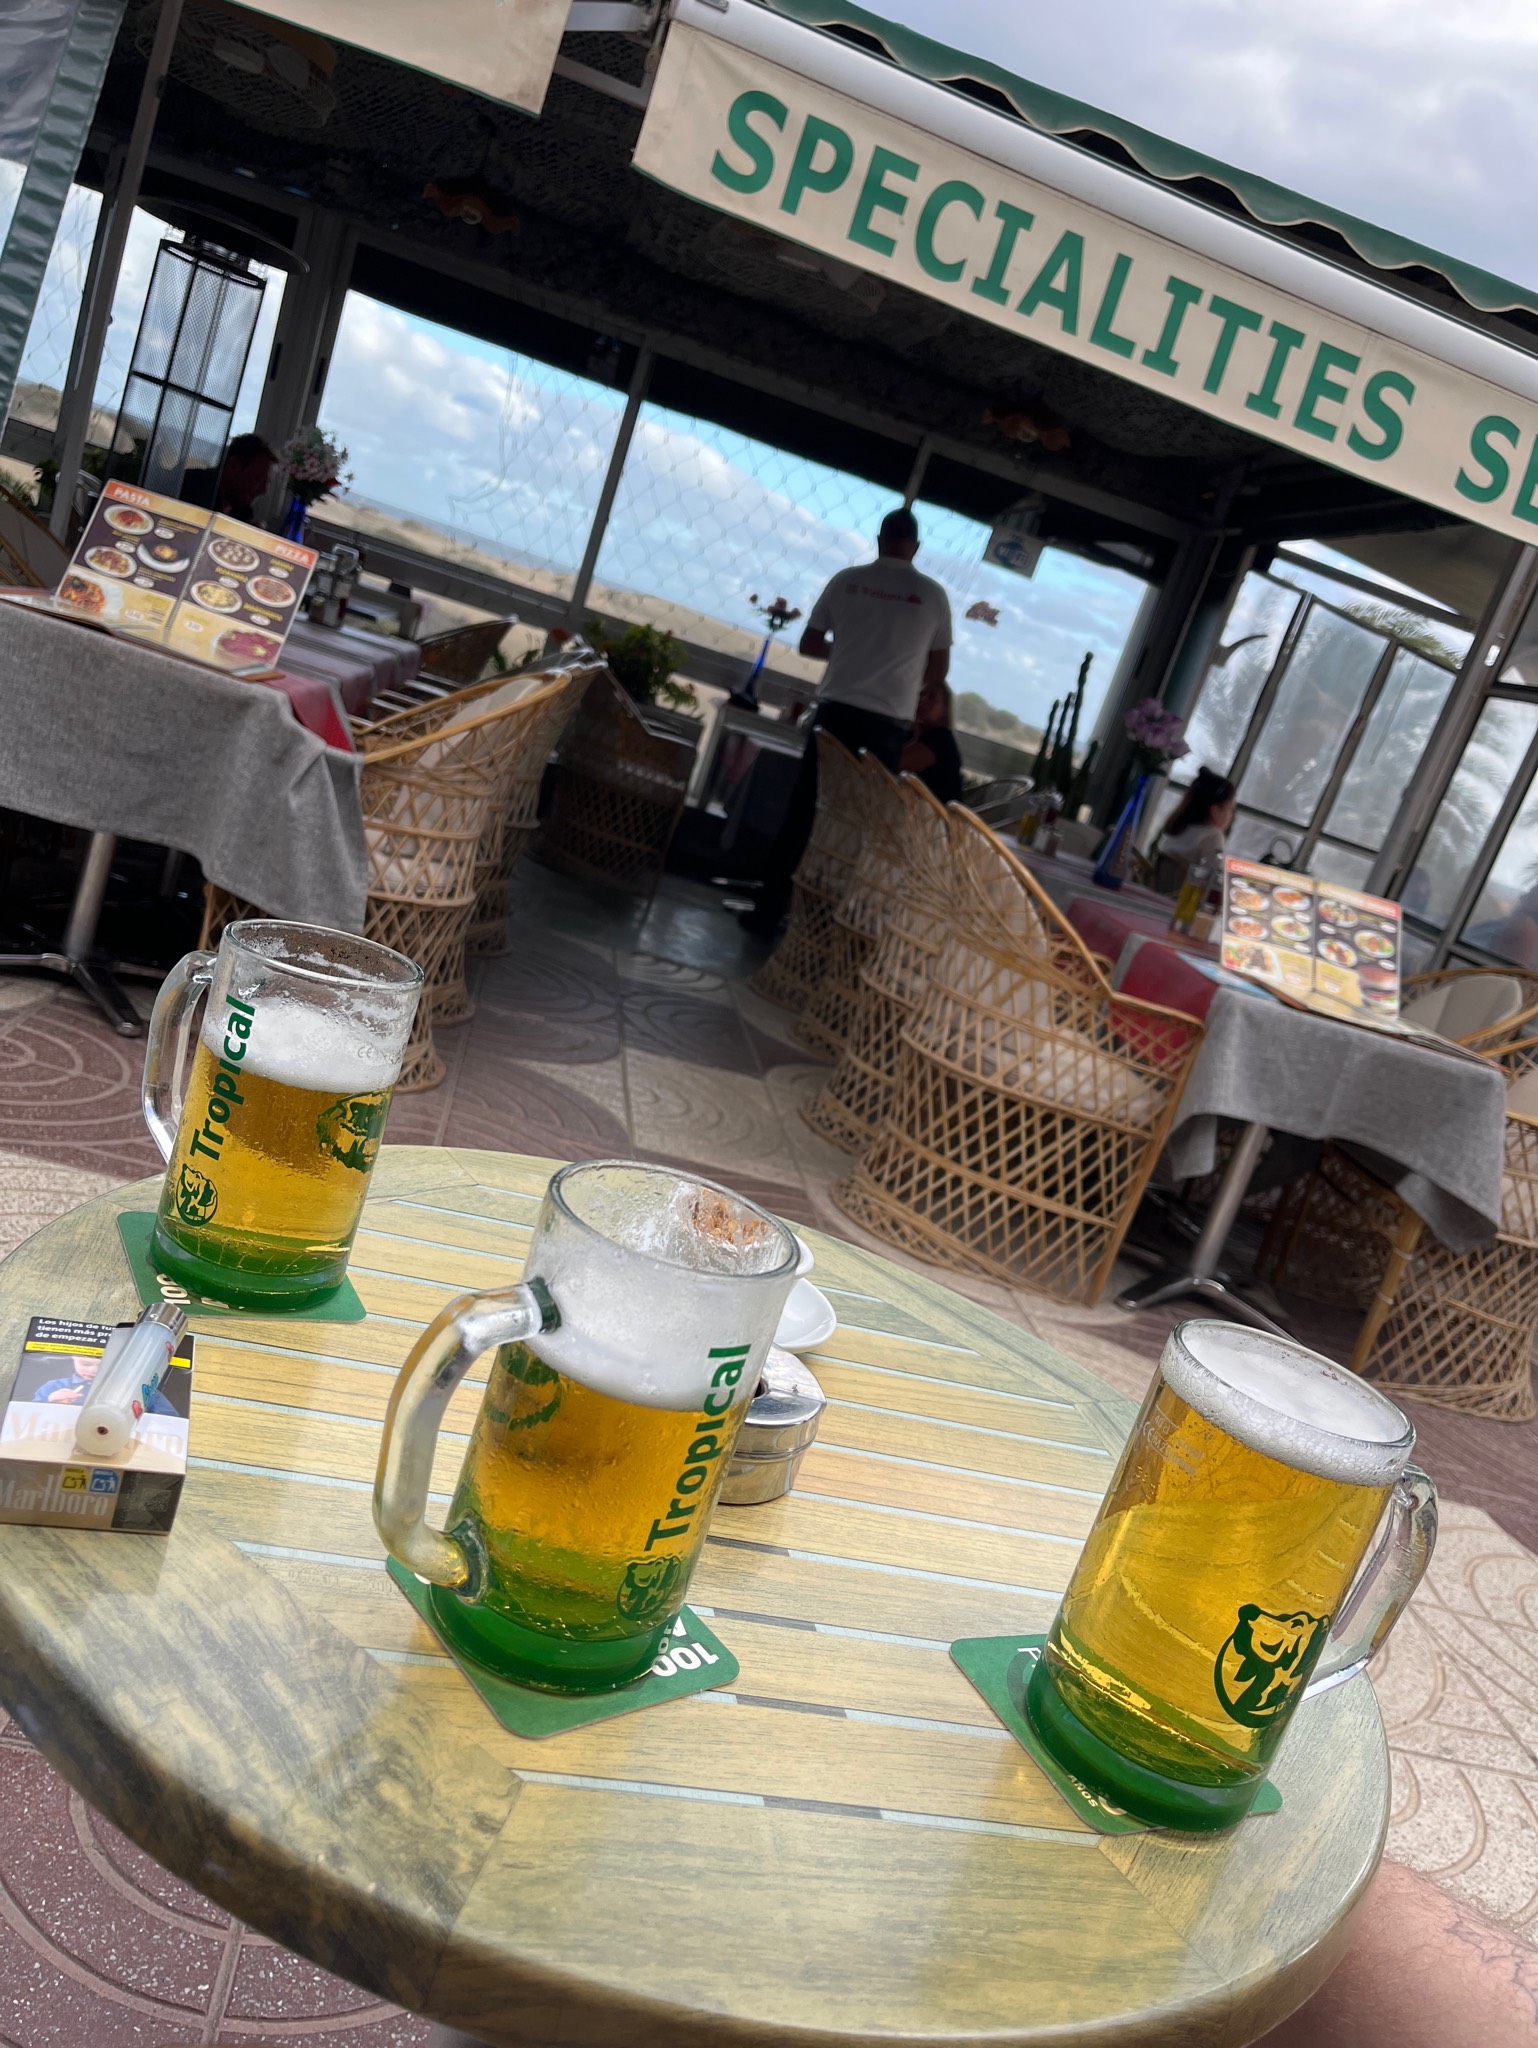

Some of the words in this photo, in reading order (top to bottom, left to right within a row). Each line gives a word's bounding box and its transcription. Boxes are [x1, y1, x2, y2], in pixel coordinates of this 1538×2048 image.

[710, 90, 1415, 461] SPECIALITIES
[114, 487, 150, 505] PASTA
[275, 545, 309, 562] PIZZA
[190, 994, 255, 1161] Tropical
[37, 1325, 71, 1333] tienen
[73, 1328, 95, 1336] más
[59, 1320, 84, 1328] hijos
[51, 1333, 98, 1343] empezar
[644, 1343, 752, 1552] Tropical
